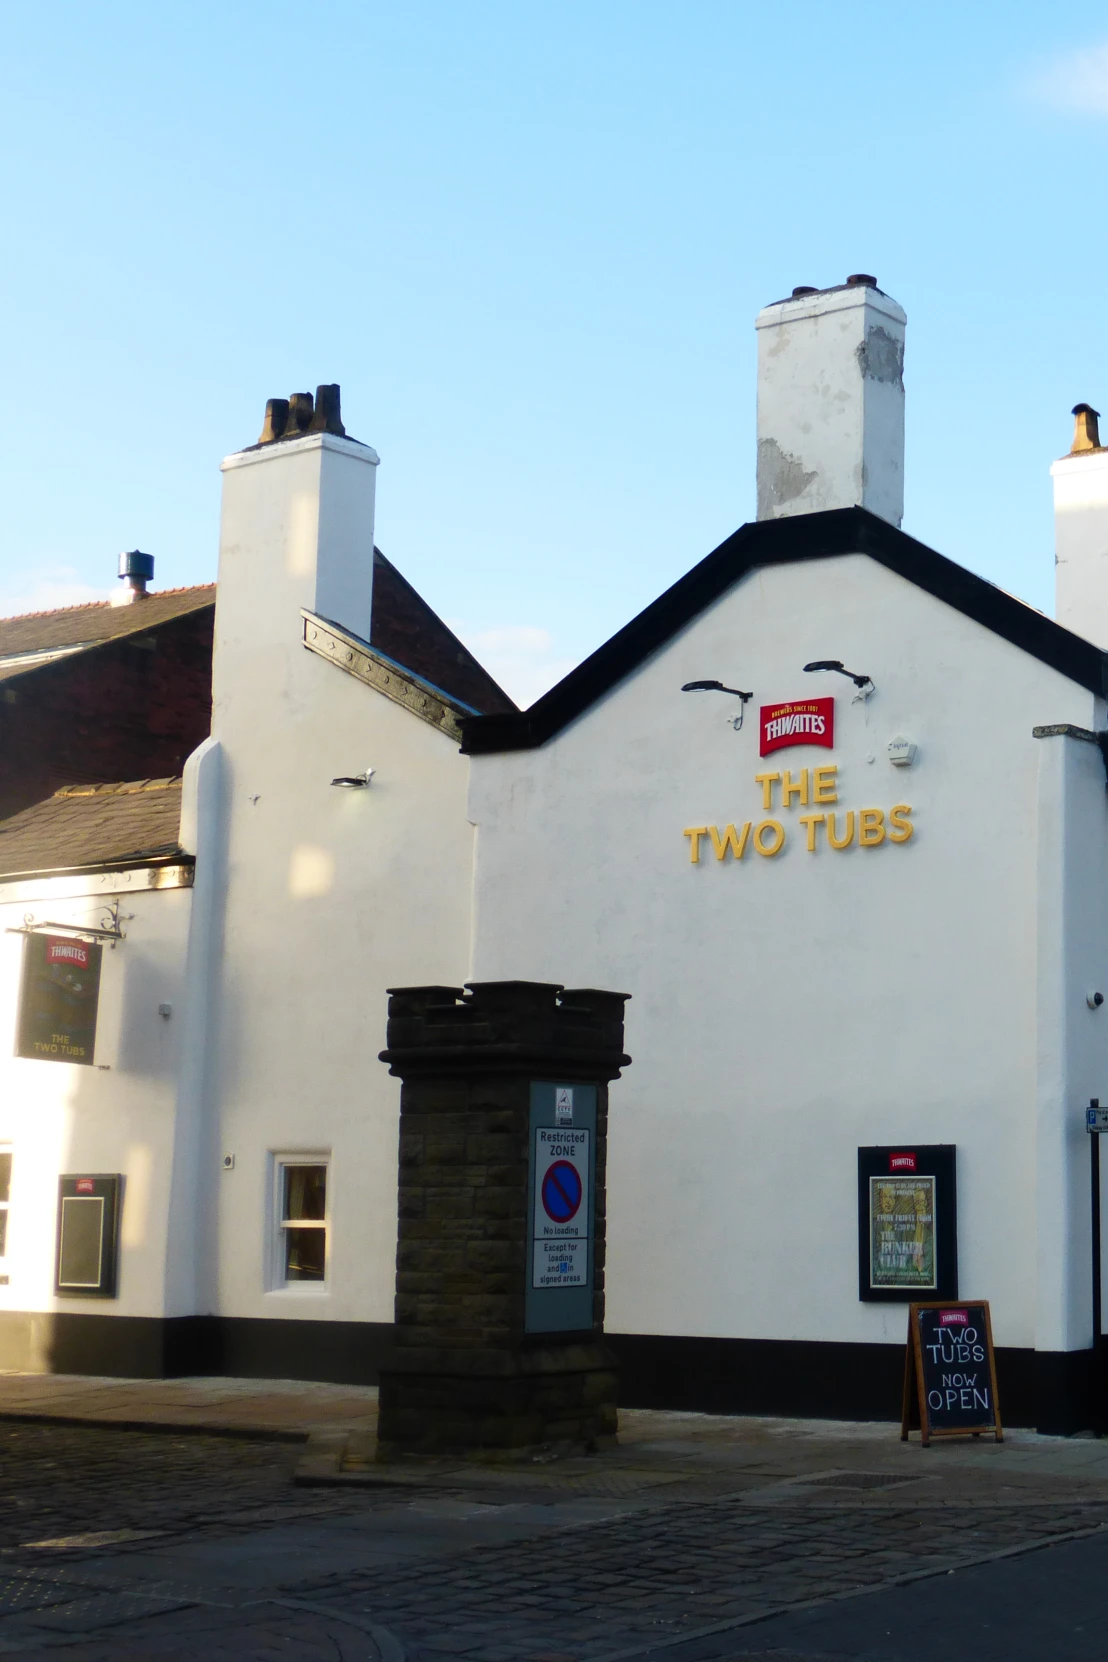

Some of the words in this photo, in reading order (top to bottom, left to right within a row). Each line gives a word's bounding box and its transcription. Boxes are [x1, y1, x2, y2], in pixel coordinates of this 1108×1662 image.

[771, 706, 792, 718] BREWERS
[765, 714, 825, 741] THWAITES
[755, 765, 837, 809] THE
[684, 820, 784, 863] TWO
[800, 805, 913, 851] TUBS
[51, 946, 86, 962] THWAITES
[52, 1034, 70, 1045] THE
[34, 1042, 58, 1053] TWO
[61, 1045, 85, 1056] TUBS
[540, 1131, 585, 1143] Restricted
[550, 1145, 575, 1156] ZONE
[543, 1226, 553, 1235] No
[554, 1226, 579, 1235] loading
[544, 1243, 566, 1252] Except
[549, 1254, 573, 1263] loading
[540, 1275, 561, 1285] signed
[933, 1328, 977, 1344] TWO
[926, 1345, 984, 1364] TUBS
[942, 1373, 977, 1387] NOW
[928, 1388, 989, 1410] OPEN
